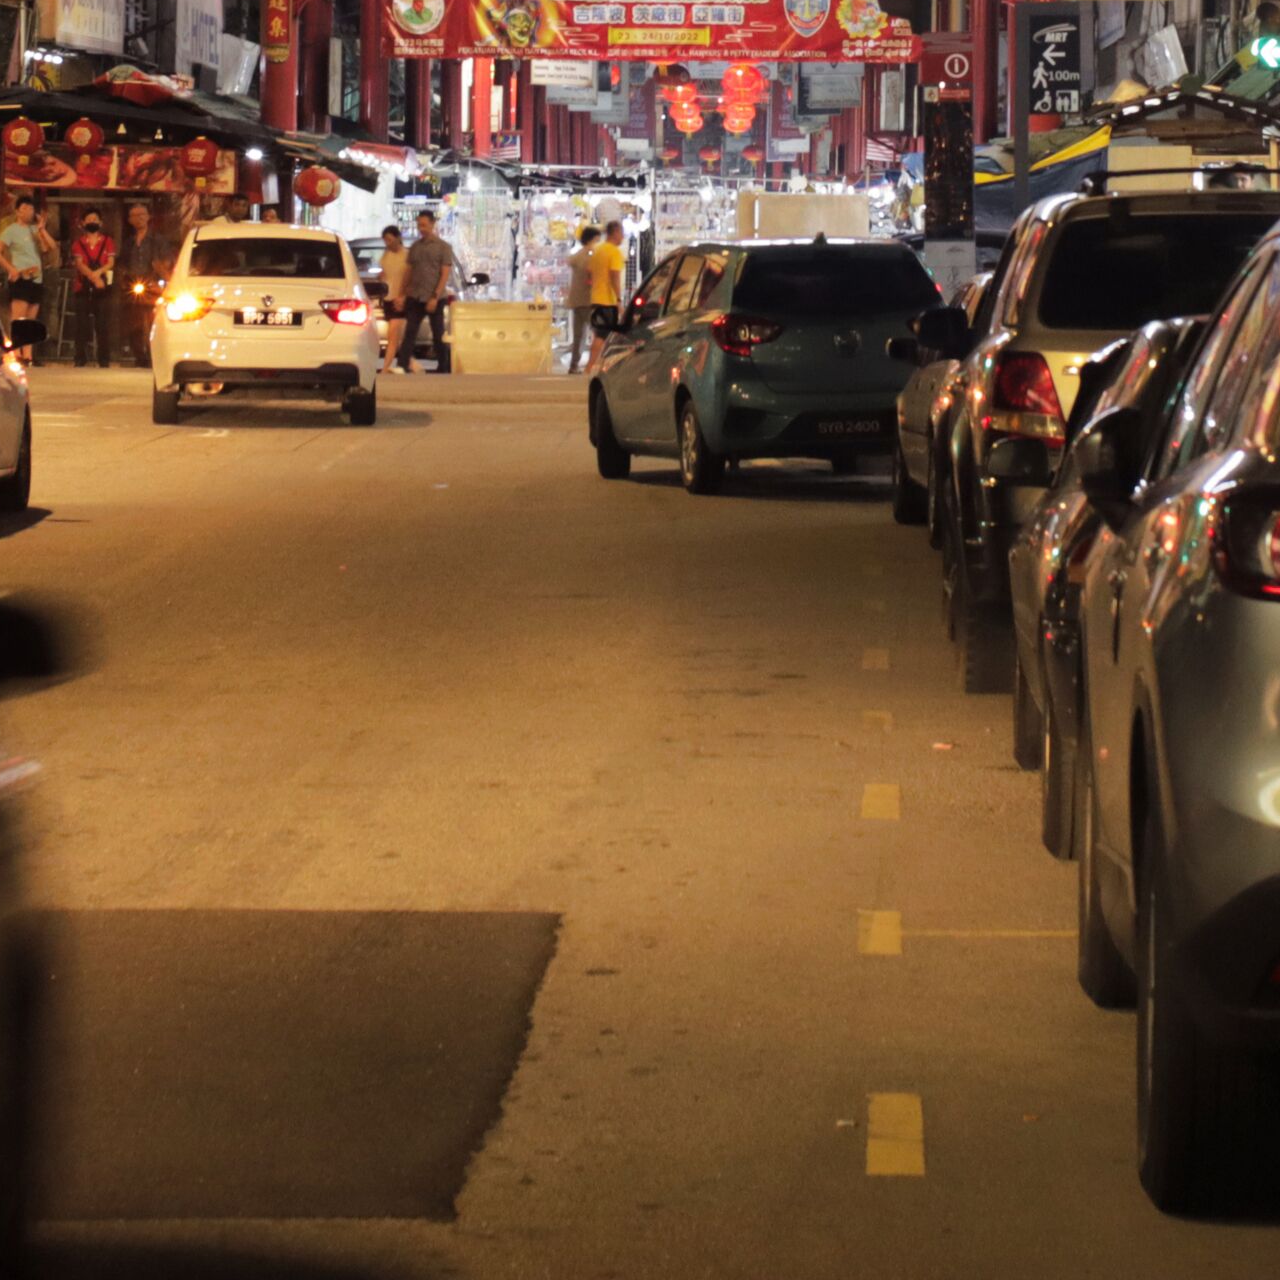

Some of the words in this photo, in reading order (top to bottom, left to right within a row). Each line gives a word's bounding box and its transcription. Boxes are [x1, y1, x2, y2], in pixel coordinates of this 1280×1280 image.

[641, 32, 700, 41] 24/10/2022
[1044, 31, 1068, 43] MRT
[1048, 70, 1080, 82] 100m
